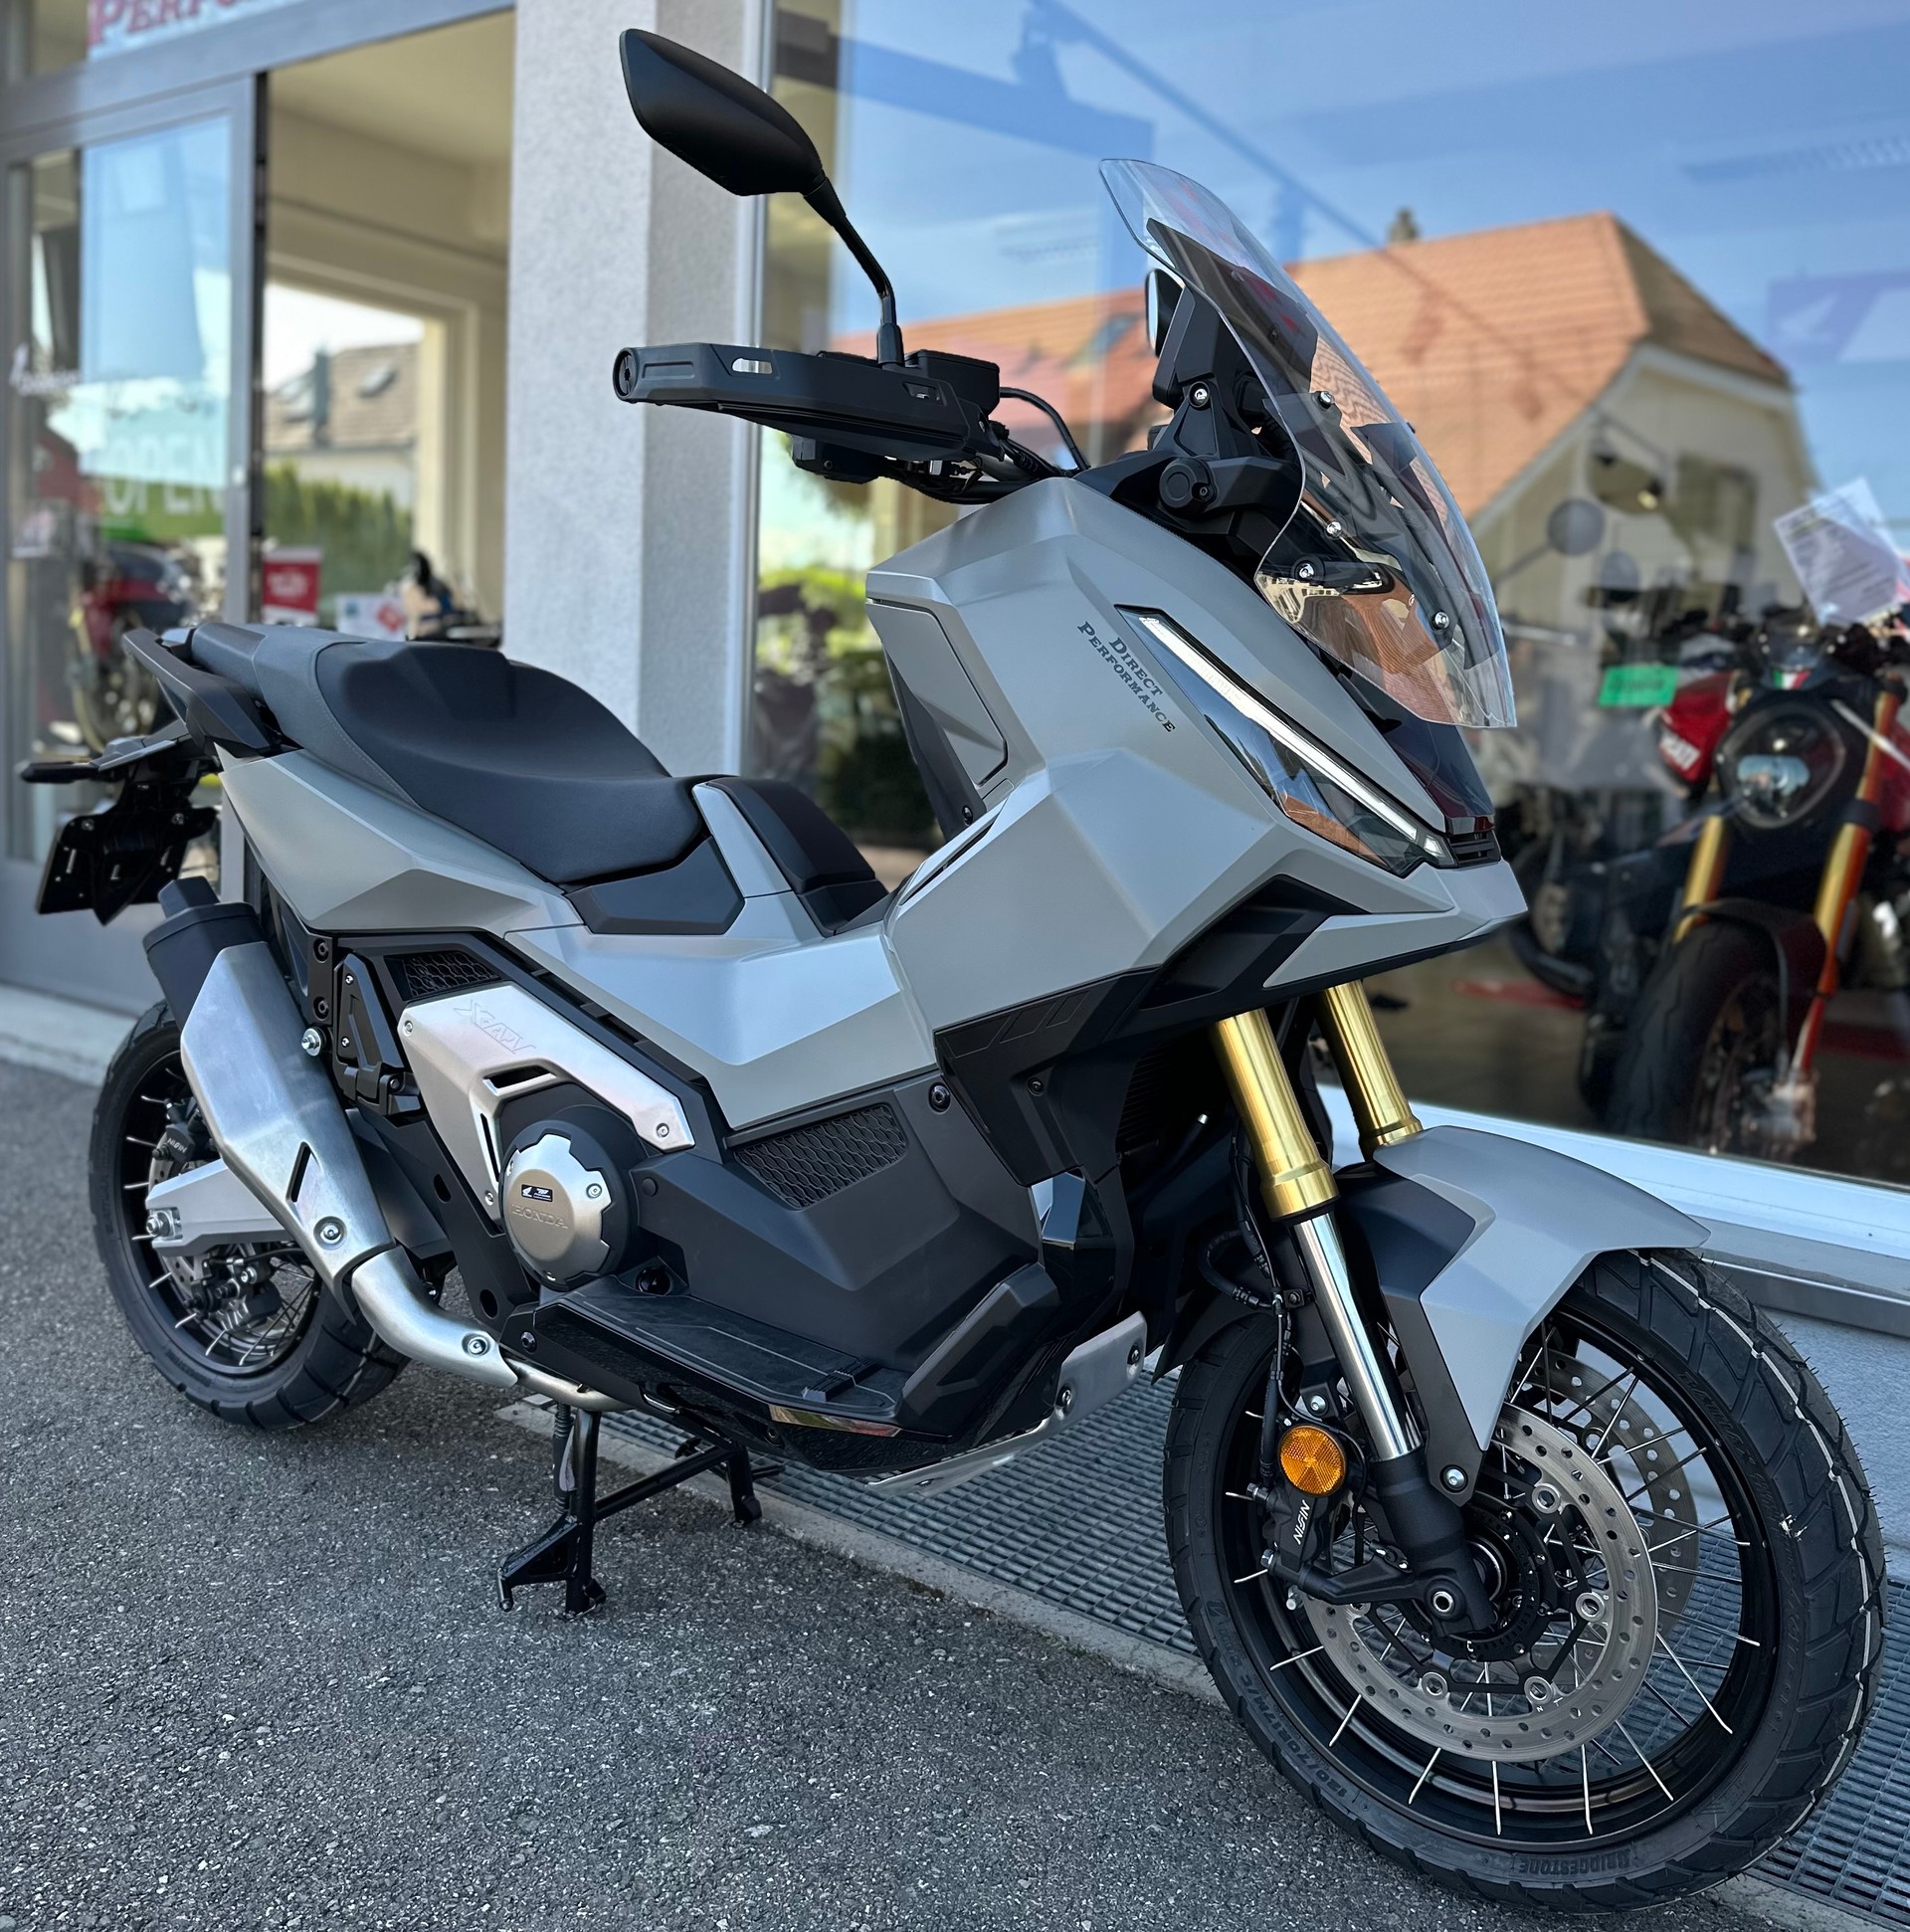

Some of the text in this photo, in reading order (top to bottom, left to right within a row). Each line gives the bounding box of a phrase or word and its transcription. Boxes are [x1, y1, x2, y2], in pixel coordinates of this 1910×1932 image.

[1076, 621, 1176, 732] PERFORMANCE
[1108, 637, 1163, 696] DIRECT
[511, 1204, 569, 1230] HONDA
[1293, 1499, 1310, 1545] NISSIN
[1519, 1848, 1632, 1875] BRIDGESTONE
